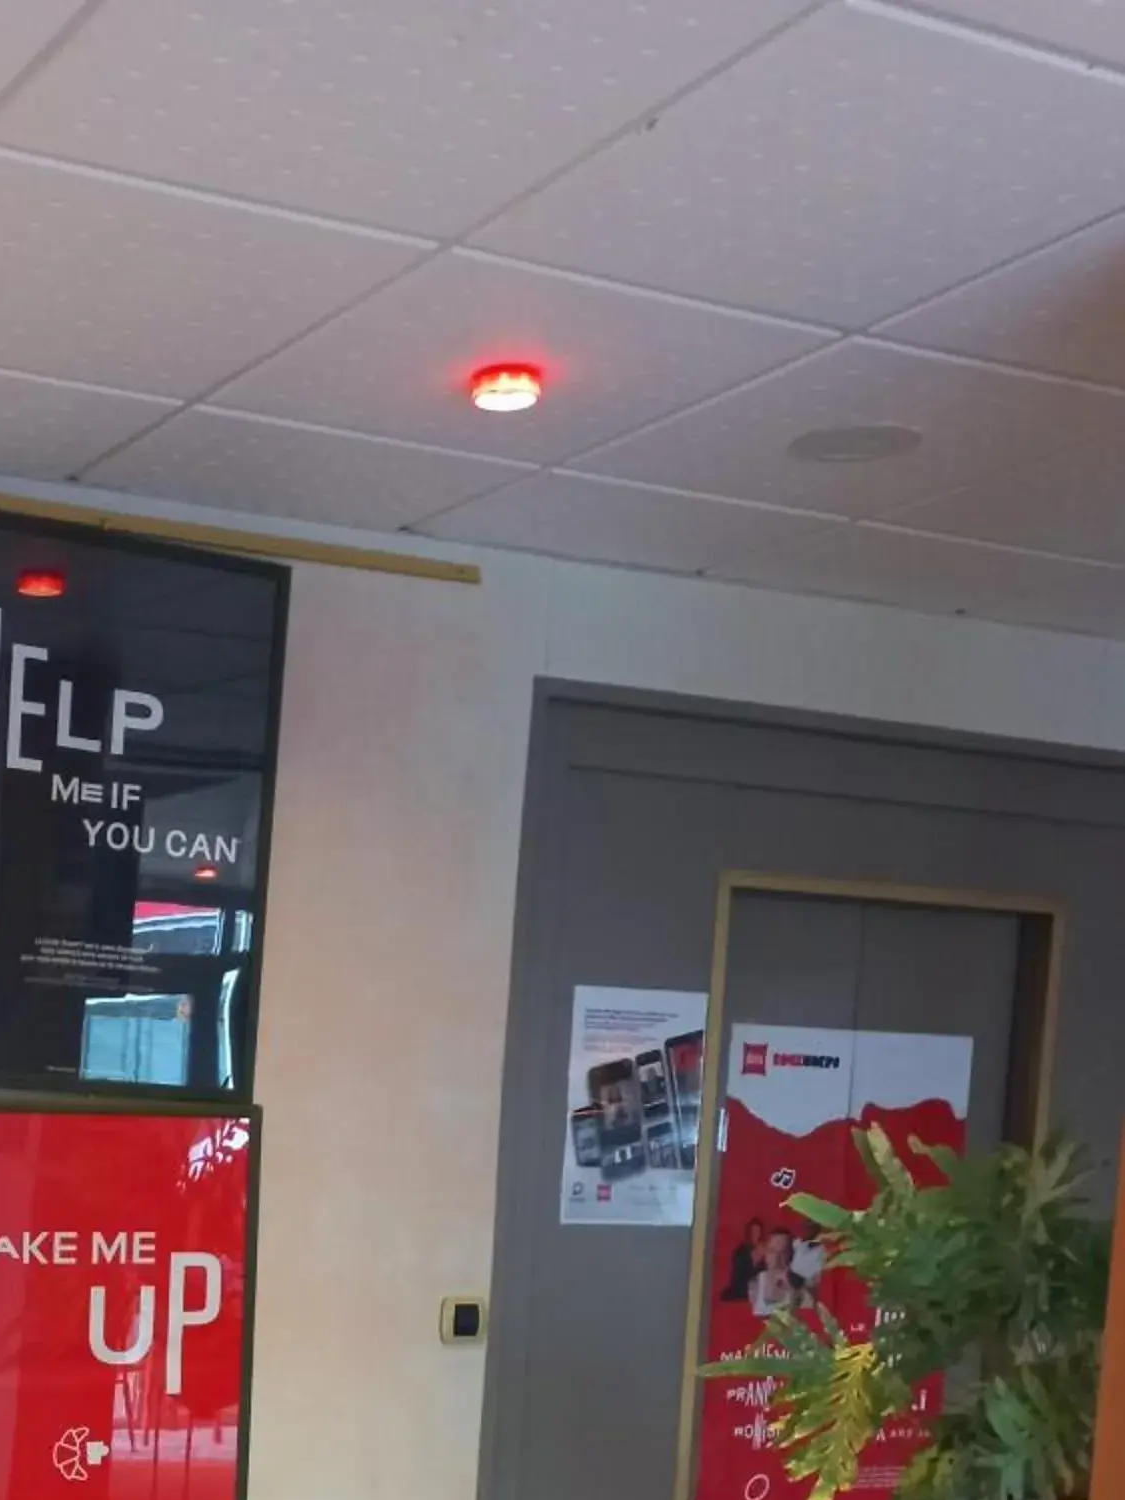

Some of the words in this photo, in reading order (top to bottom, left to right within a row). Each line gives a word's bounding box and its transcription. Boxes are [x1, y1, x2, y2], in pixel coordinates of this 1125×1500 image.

[111, 784, 142, 810] IF
[82, 820, 156, 854] YOU
[165, 831, 238, 863] CAN
[91, 1231, 157, 1265] ME
[88, 1251, 223, 1395] UP
